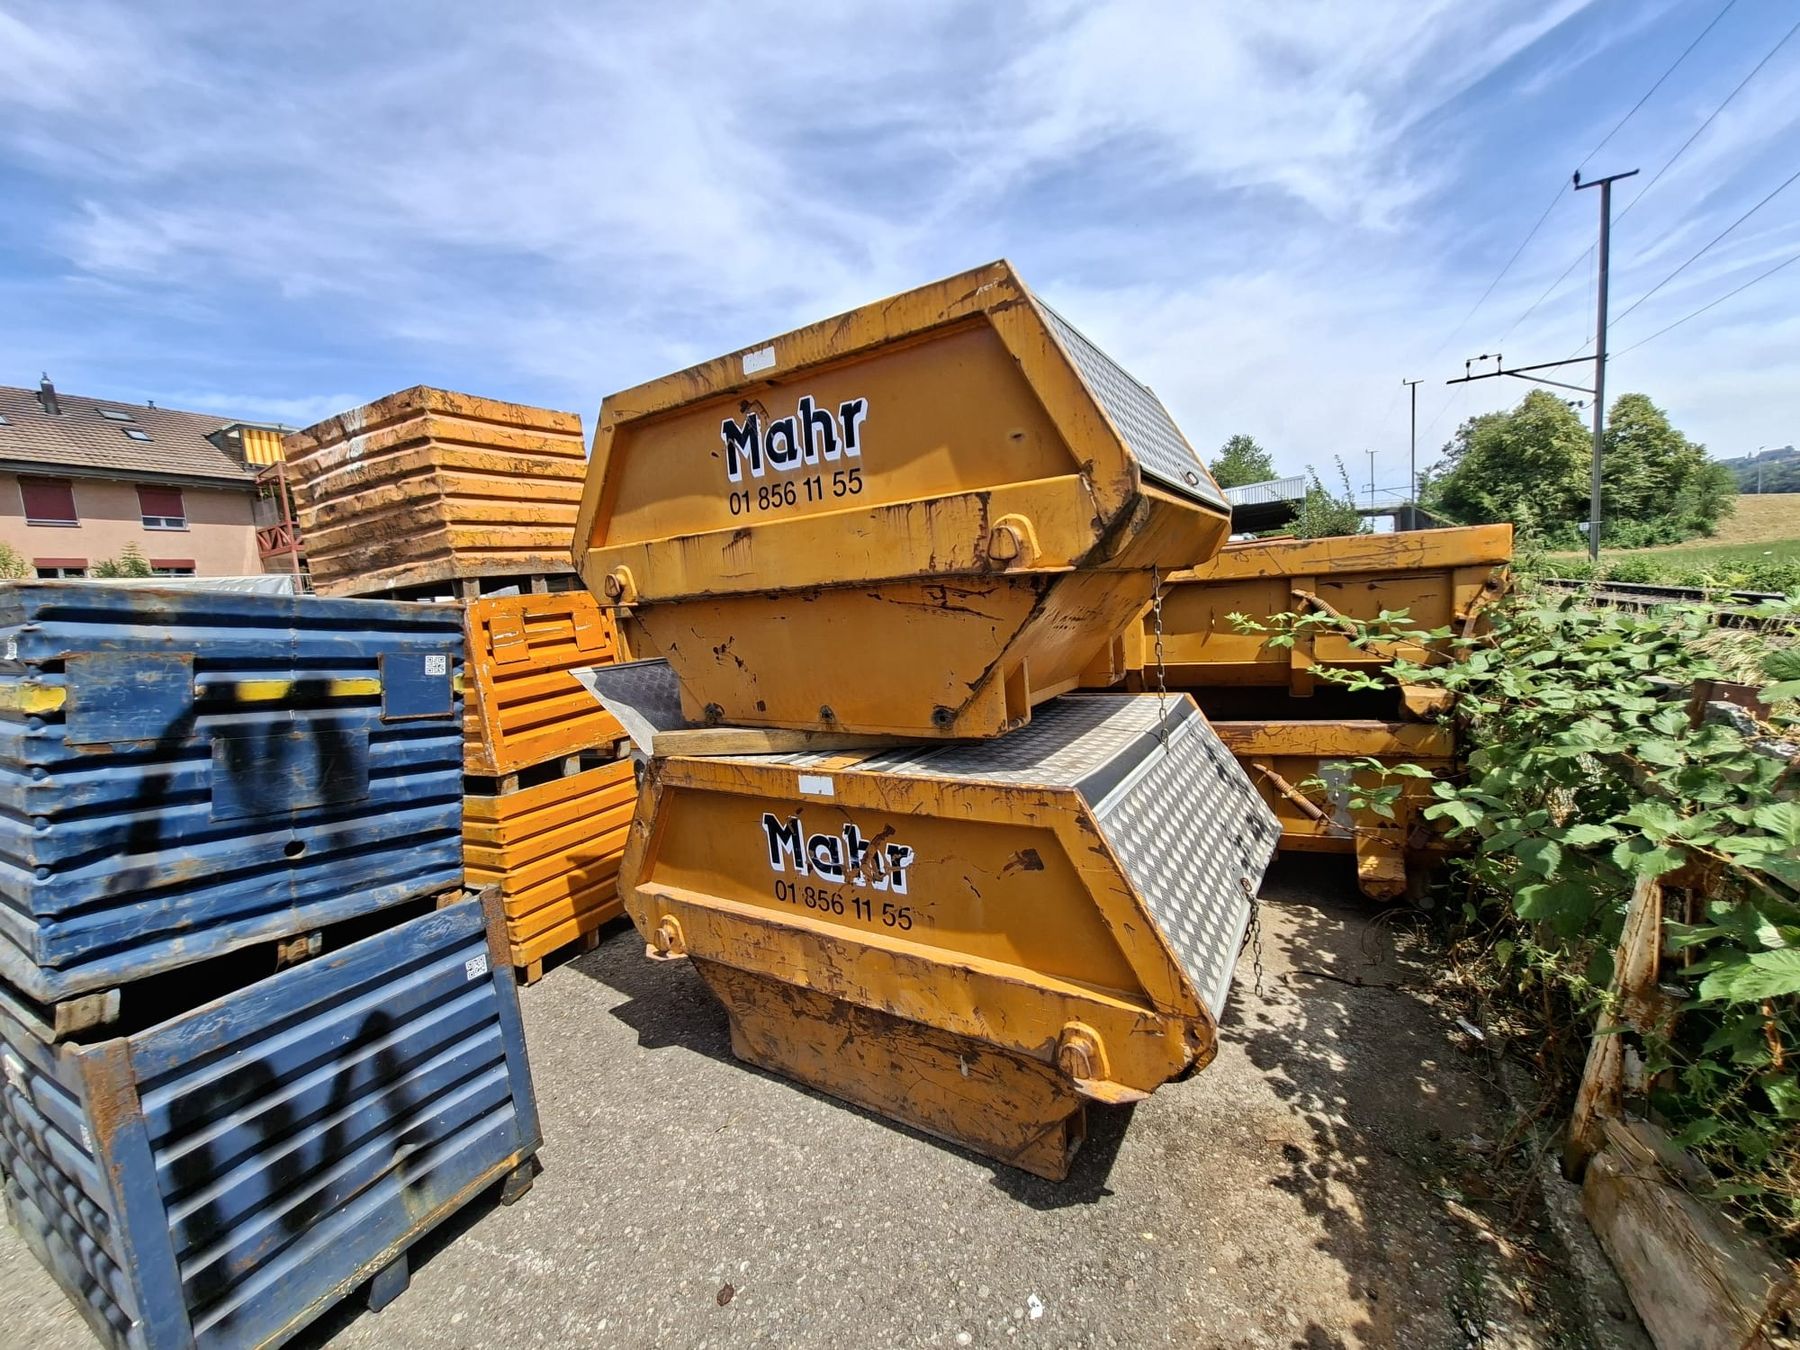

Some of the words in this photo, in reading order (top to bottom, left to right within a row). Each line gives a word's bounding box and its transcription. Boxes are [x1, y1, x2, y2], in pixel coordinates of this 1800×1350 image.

[721, 395, 868, 482] Mahr
[729, 491, 750, 515] 01
[758, 482, 797, 510] 856
[803, 476, 823, 502] 11
[833, 468, 863, 497] 55
[761, 813, 914, 895] Mahr
[775, 880, 797, 904] 01
[804, 887, 844, 915] 856
[852, 897, 871, 922] 11
[882, 904, 913, 931] 55
